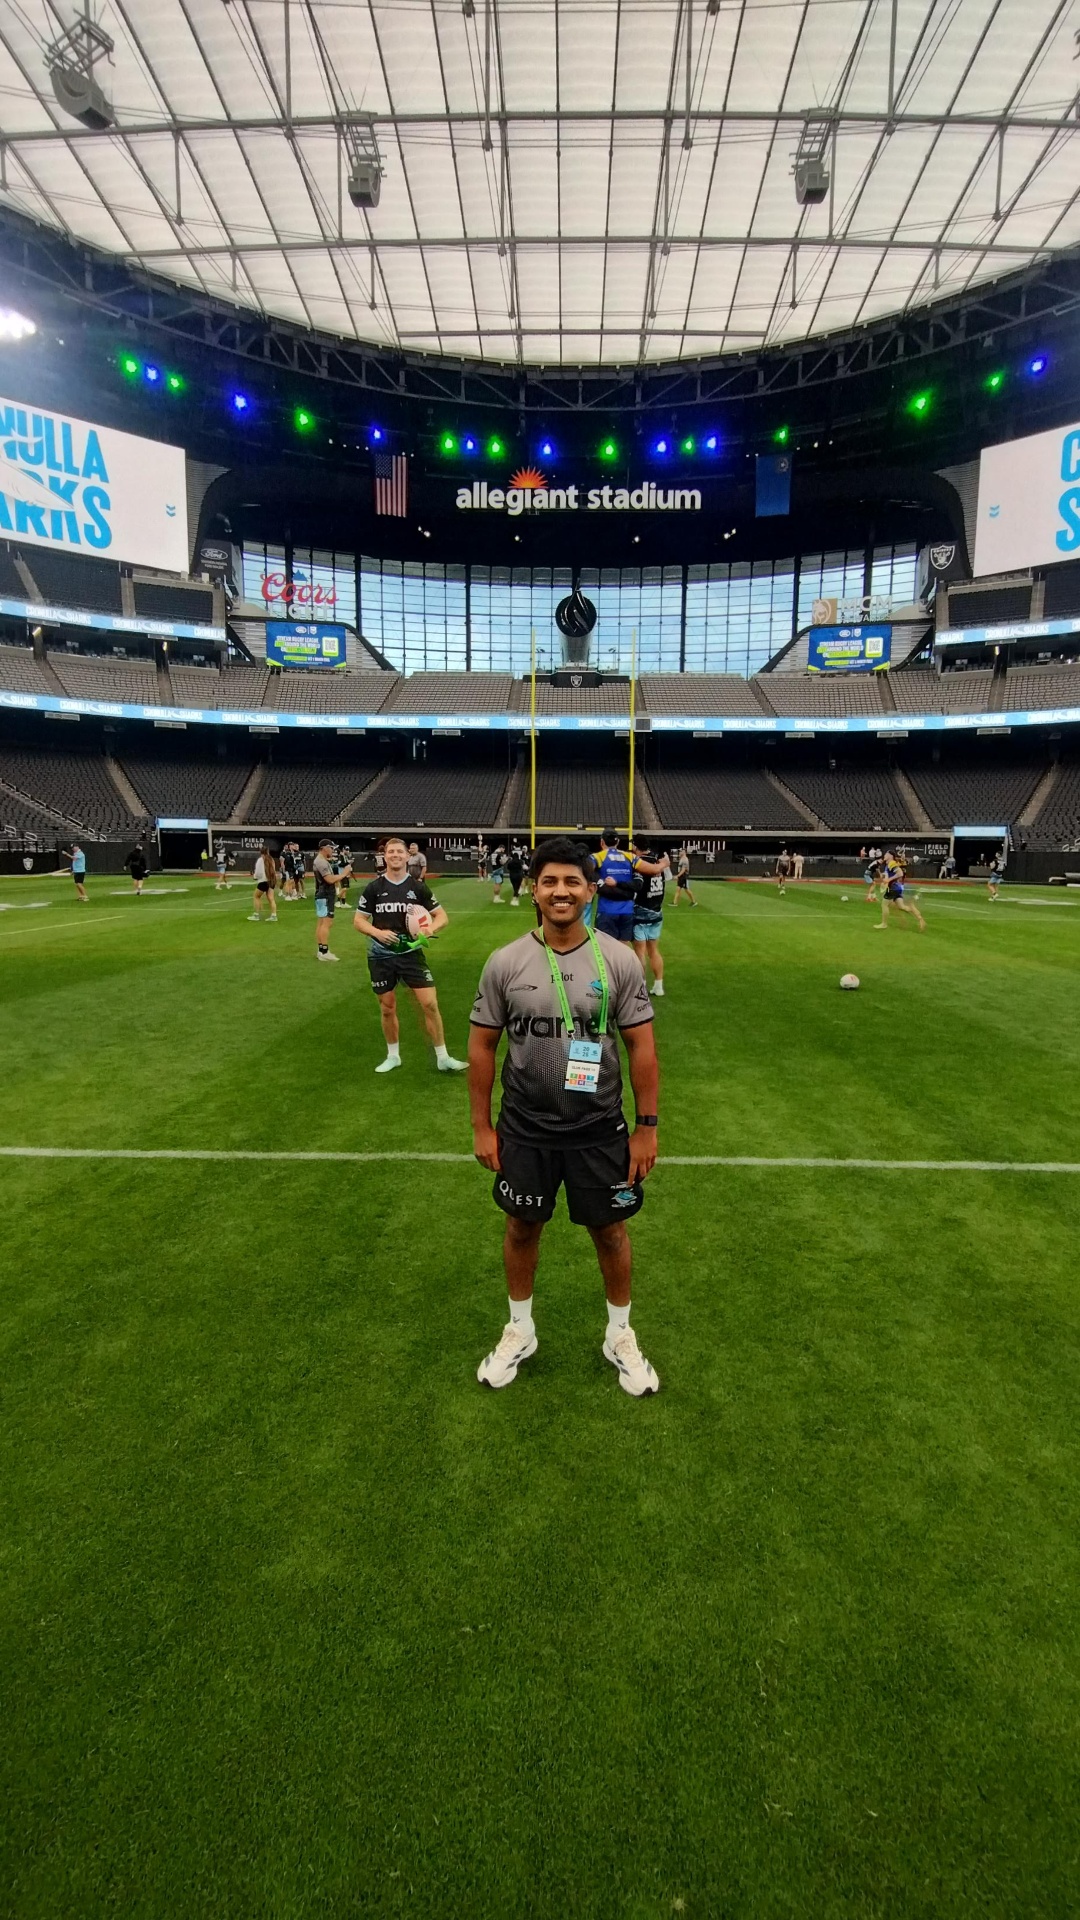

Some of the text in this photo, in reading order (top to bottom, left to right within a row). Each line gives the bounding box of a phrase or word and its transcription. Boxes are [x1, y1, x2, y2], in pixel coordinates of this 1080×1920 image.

[456, 481, 701, 515] allegiant stadium
[260, 572, 339, 604] Coors
[67, 611, 91, 625] SHARKS
[150, 622, 174, 634] SHARKS
[1024, 624, 1049, 636] SHARKS
[551, 972, 574, 983] plot
